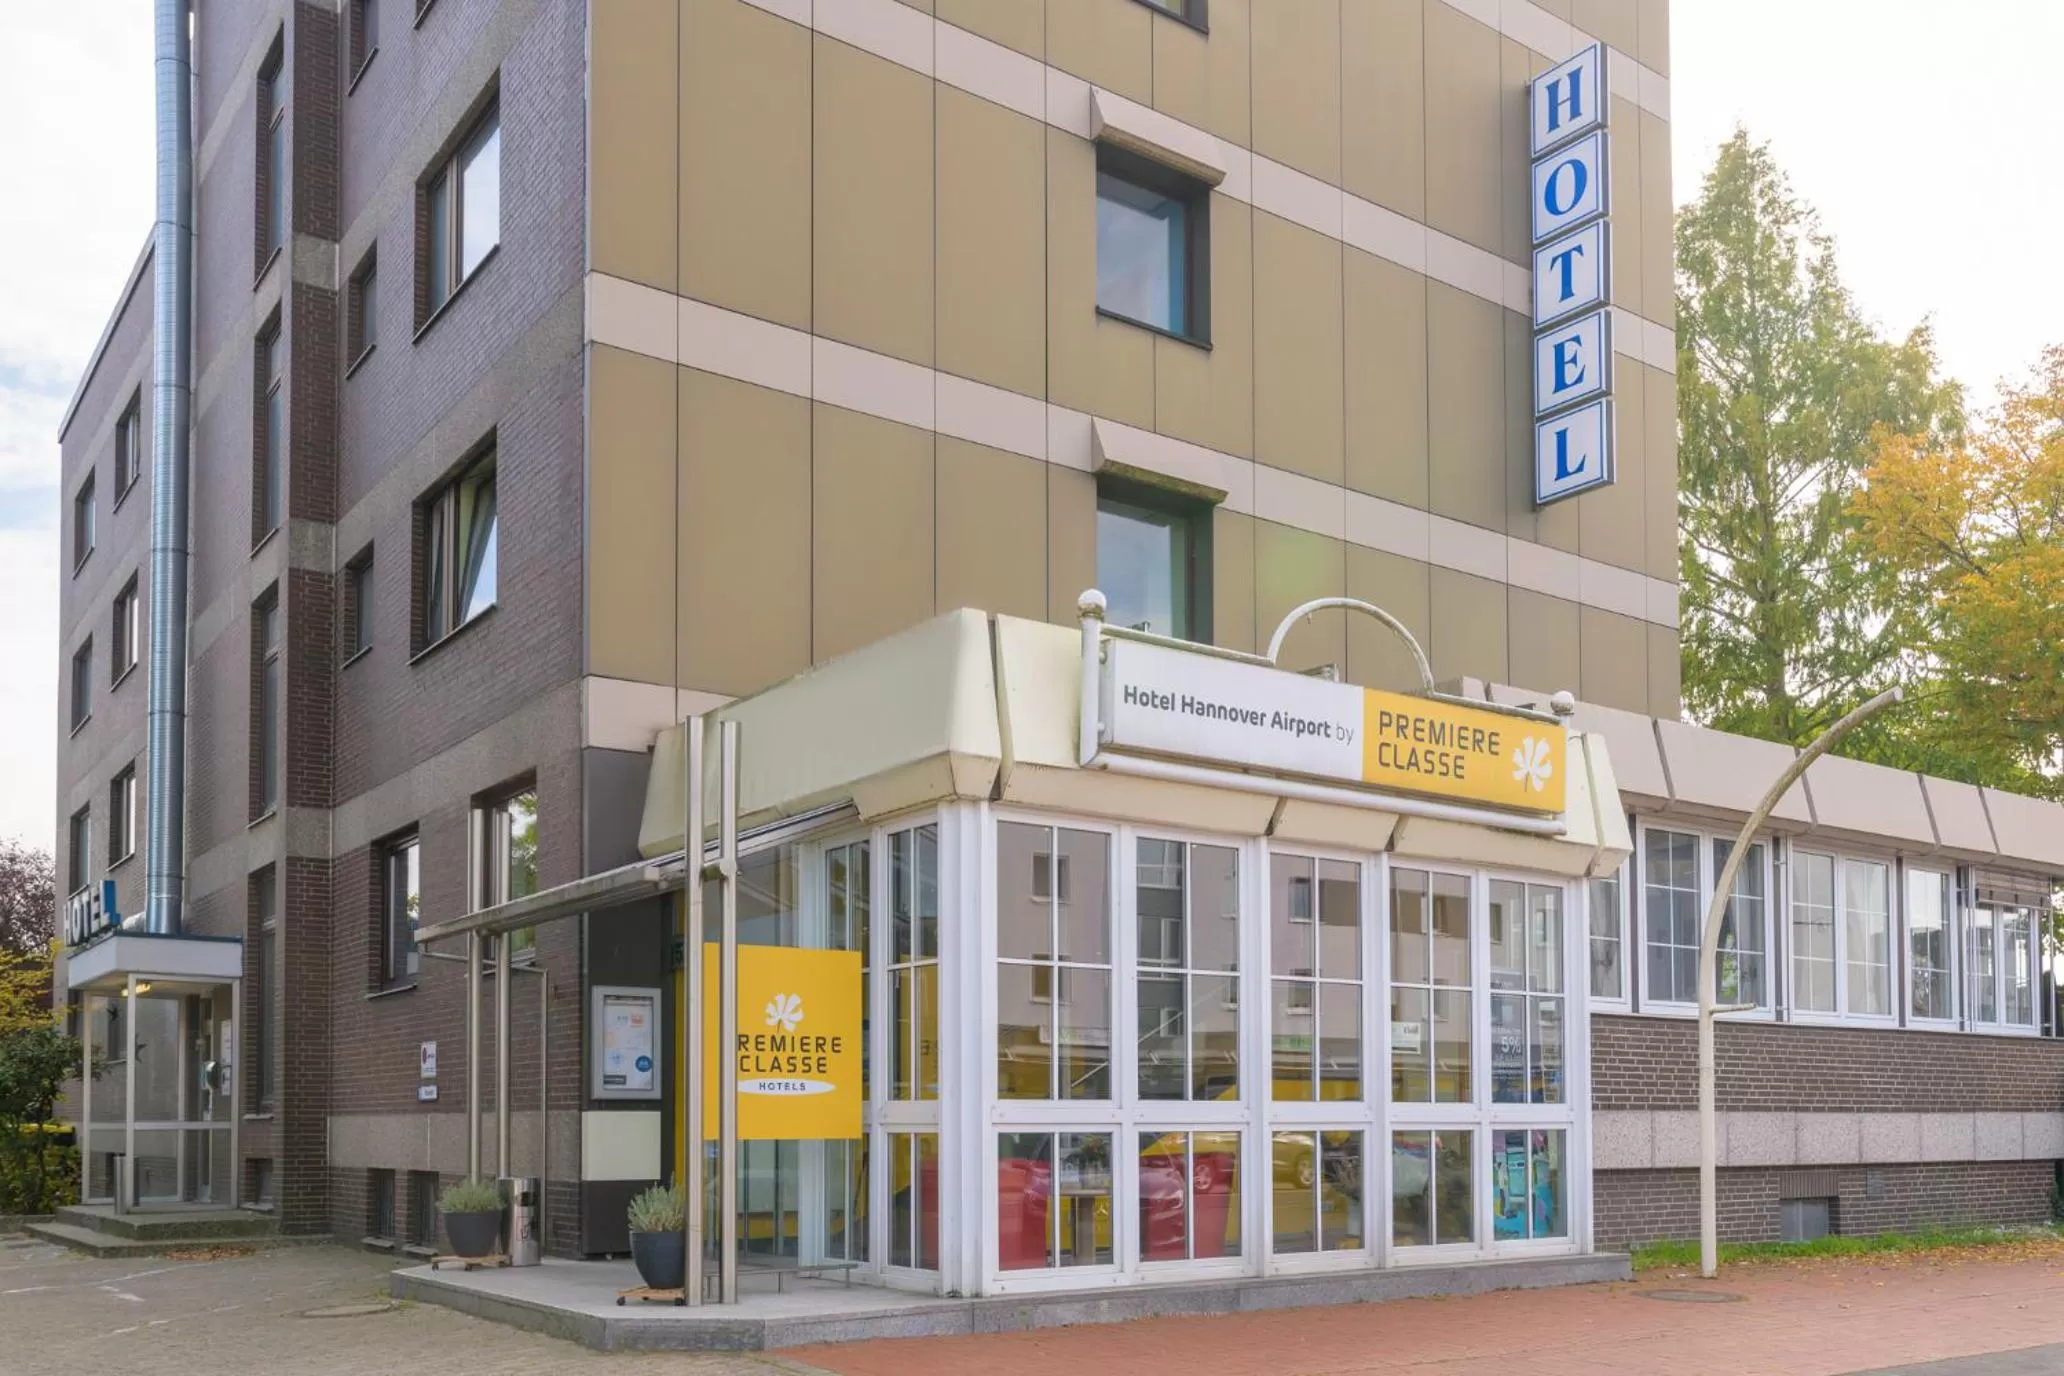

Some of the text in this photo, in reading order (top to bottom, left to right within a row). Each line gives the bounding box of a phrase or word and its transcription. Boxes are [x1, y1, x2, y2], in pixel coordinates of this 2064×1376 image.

[1544, 65, 1588, 483] HOTEL
[1123, 684, 1354, 746] Hotel Hannover Airport by
[1379, 710, 1500, 756] PREMIERE
[1378, 742, 1465, 779] CLASSE
[63, 880, 112, 946] HOTEL
[738, 1034, 842, 1053] REMIERE
[740, 1055, 827, 1074] CLASSE
[759, 1082, 806, 1091] HOTELS
